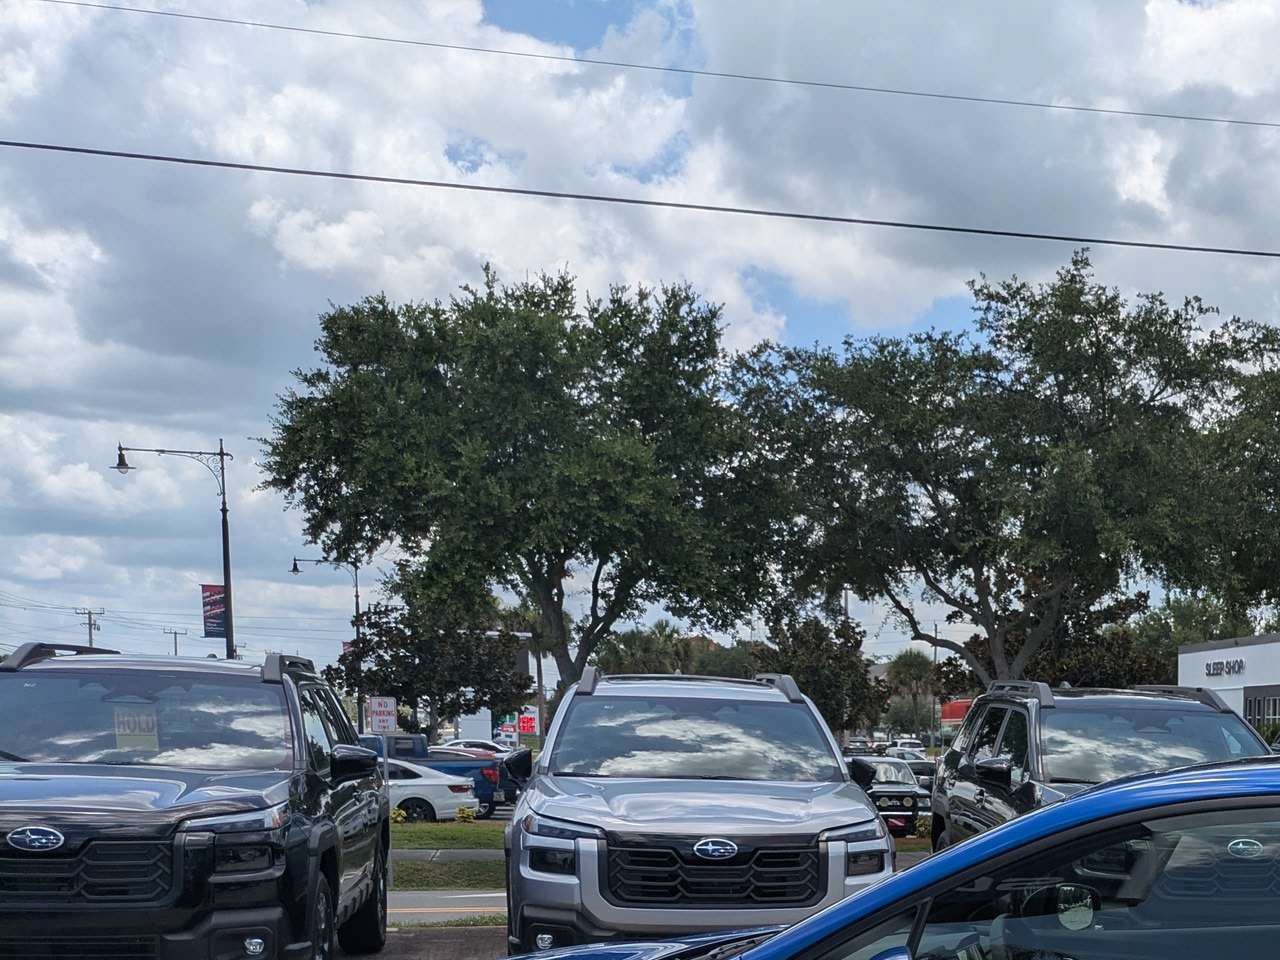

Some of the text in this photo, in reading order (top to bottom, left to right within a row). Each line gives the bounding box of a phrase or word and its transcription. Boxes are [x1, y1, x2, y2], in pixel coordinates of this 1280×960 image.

[1205, 659, 1244, 676] SLEEP SHOP
[377, 701, 389, 709] NO
